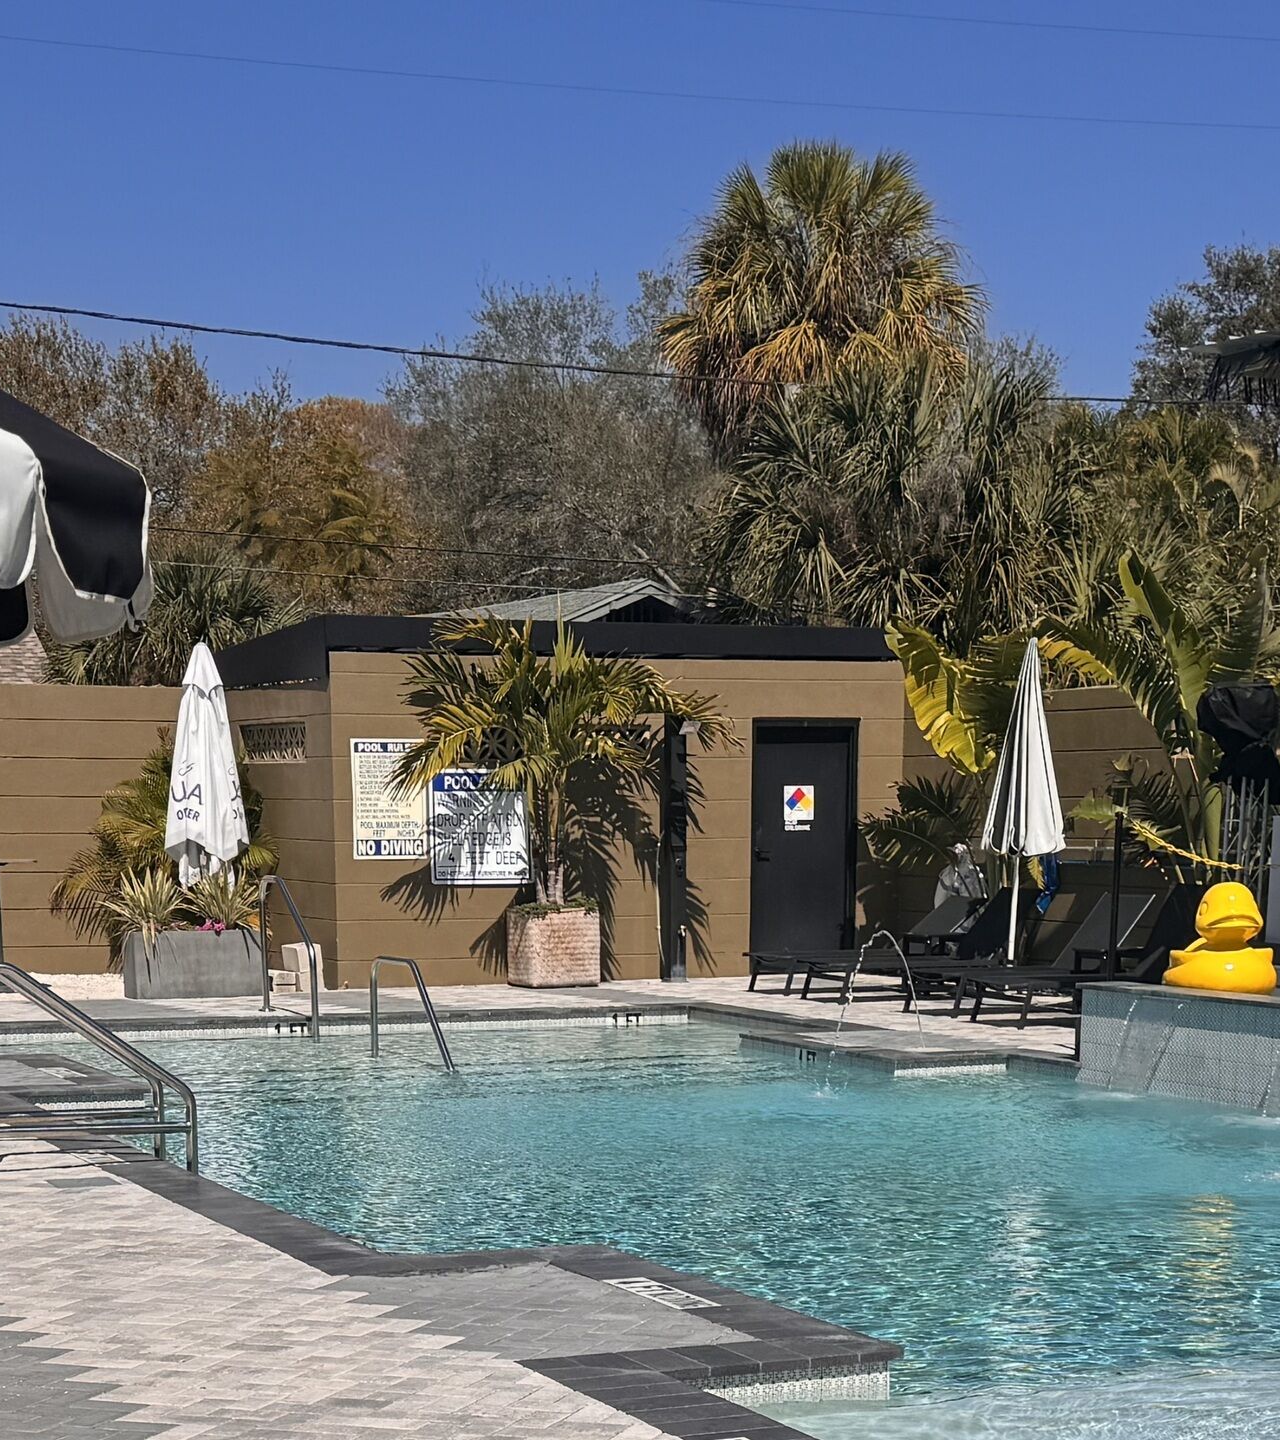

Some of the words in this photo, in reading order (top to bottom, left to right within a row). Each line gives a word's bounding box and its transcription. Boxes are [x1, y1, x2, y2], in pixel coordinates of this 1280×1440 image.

[358, 743, 383, 752] POOL
[388, 743, 410, 753] RULE
[360, 821, 374, 829] POOL
[373, 829, 386, 838] FEET
[471, 832, 499, 846] EDGE
[502, 832, 512, 846] IS
[358, 840, 376, 855] NO
[381, 839, 423, 855] DIVING
[466, 851, 491, 865] FEET
[495, 851, 523, 865] DEEP
[289, 1022, 307, 1034] FT
